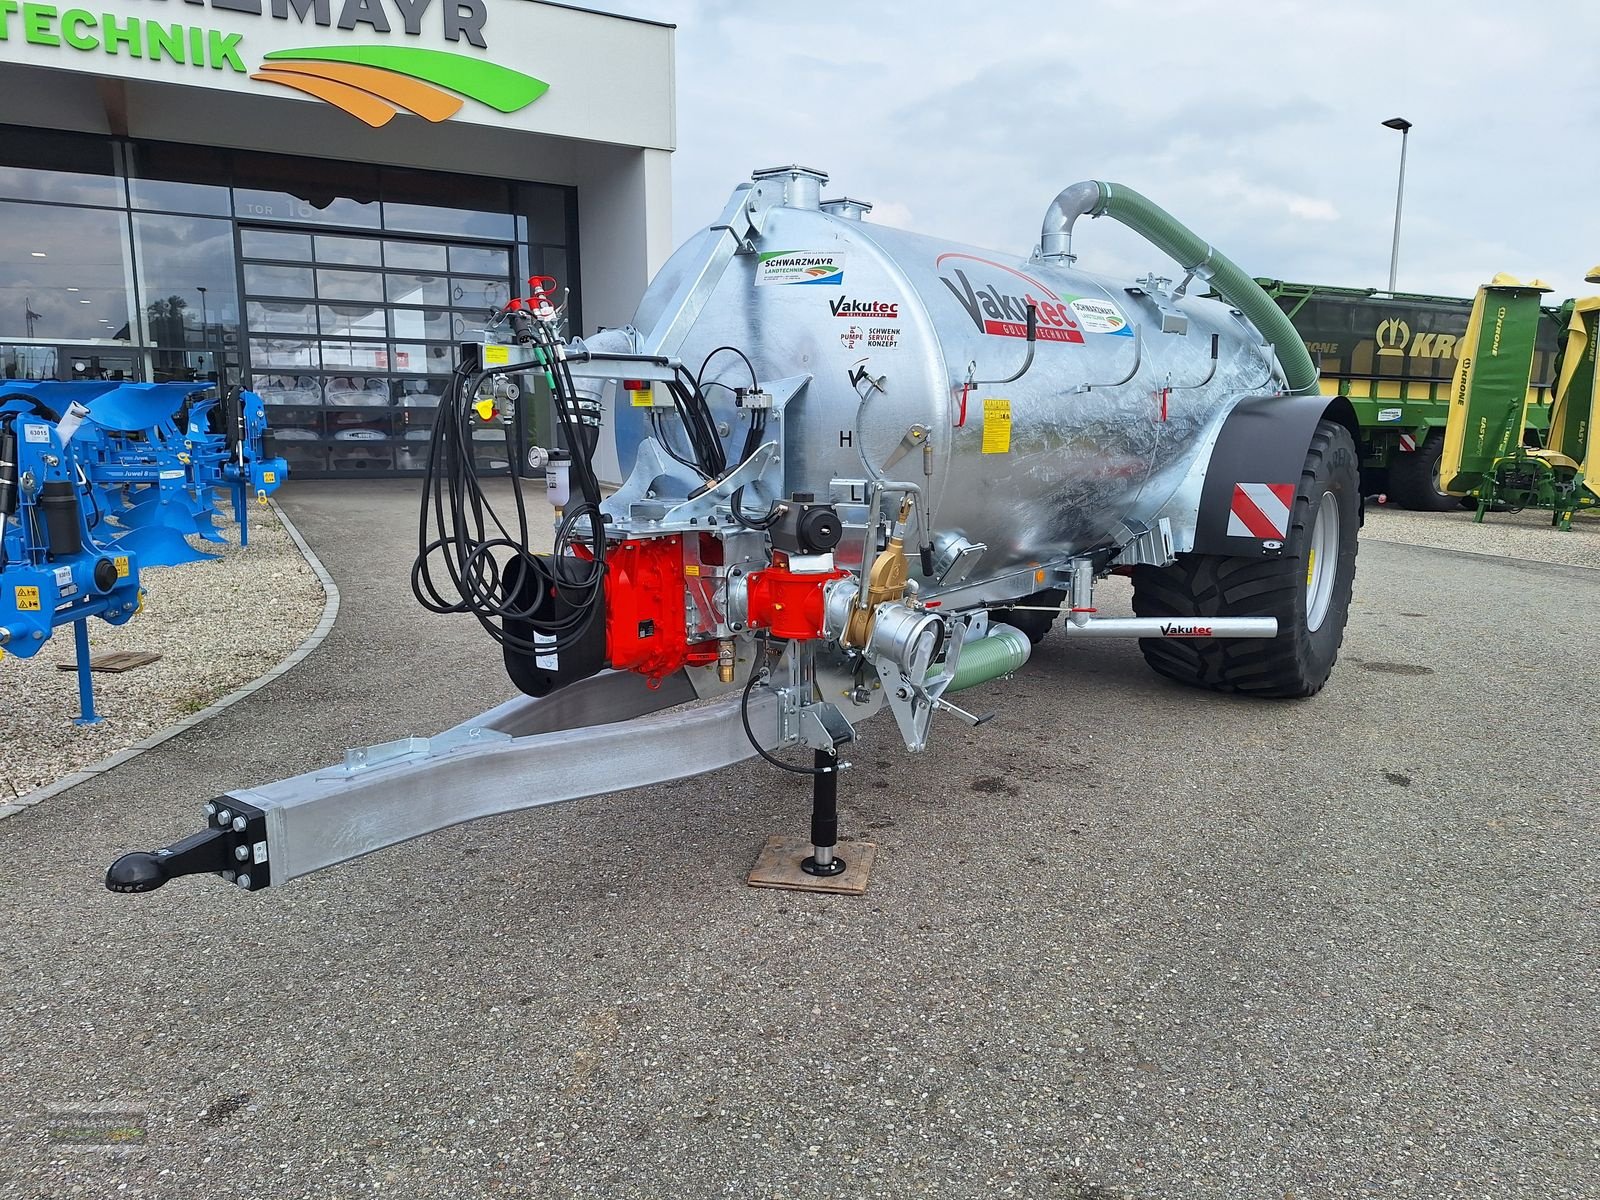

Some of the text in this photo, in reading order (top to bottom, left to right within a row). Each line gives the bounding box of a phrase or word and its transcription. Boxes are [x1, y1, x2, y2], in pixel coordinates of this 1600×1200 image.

[0, 1, 248, 73] TECHNIK
[247, 204, 273, 215] TOR
[764, 258, 833, 268] SCHWARZMAYR
[764, 267, 804, 275] LANDTECHNIK
[829, 295, 899, 317] Vakutec
[938, 268, 1077, 334] Vakutec
[867, 340, 898, 348] KONZEPT
[1491, 318, 1505, 357] KRONE
[1457, 369, 1468, 406] KRONE
[840, 430, 852, 448] H
[851, 484, 862, 501] L
[1160, 622, 1212, 636] Vakutec
